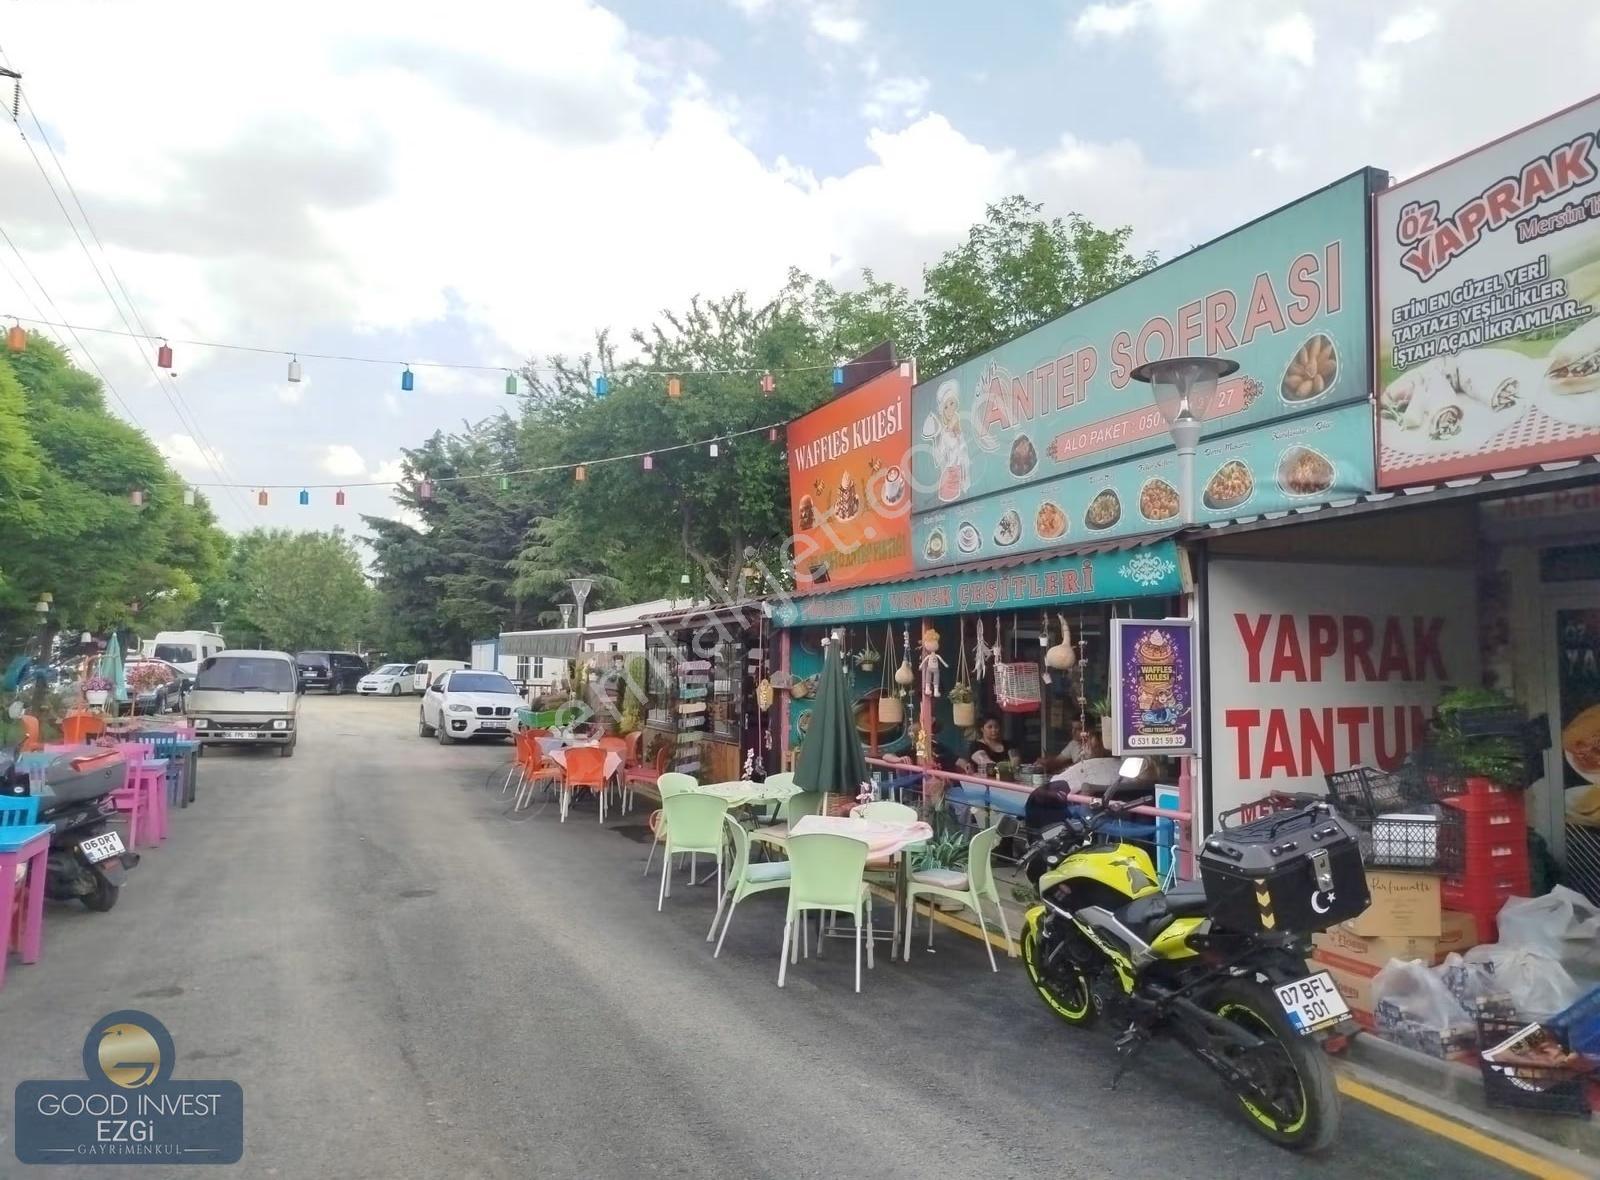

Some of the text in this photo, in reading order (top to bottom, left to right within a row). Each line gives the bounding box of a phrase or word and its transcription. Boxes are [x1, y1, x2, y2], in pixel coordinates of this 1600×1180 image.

[1398, 201, 1439, 245] ÖZ
[1401, 132, 1597, 282] YAPRAK
[1393, 255, 1548, 324] ETİN EN GÜZEL YERİ
[1393, 279, 1566, 345] TAPTAZE YEŞİLLİKLER
[982, 241, 1341, 437] ANTEP SOFRASI
[1393, 300, 1592, 370] İŞTAH AÇAN İKRAMLAR...
[795, 395, 903, 473] WAFFLES KULESİ
[1064, 433, 1088, 451] ALO
[1088, 422, 1131, 445] PAKET
[1138, 411, 1169, 434] 050
[863, 594, 884, 615] EV
[888, 585, 953, 613] YEMEK
[958, 558, 1095, 610] ÇEŞİTLERİ
[1141, 666, 1173, 674] WAFFLES
[1234, 613, 1449, 682] YAPRAK
[83, 833, 116, 851] 06 DRT
[97, 844, 116, 855] 114
[1279, 986, 1299, 1006] 07
[1299, 977, 1333, 1000] BFL
[1303, 1000, 1330, 1021] 501
